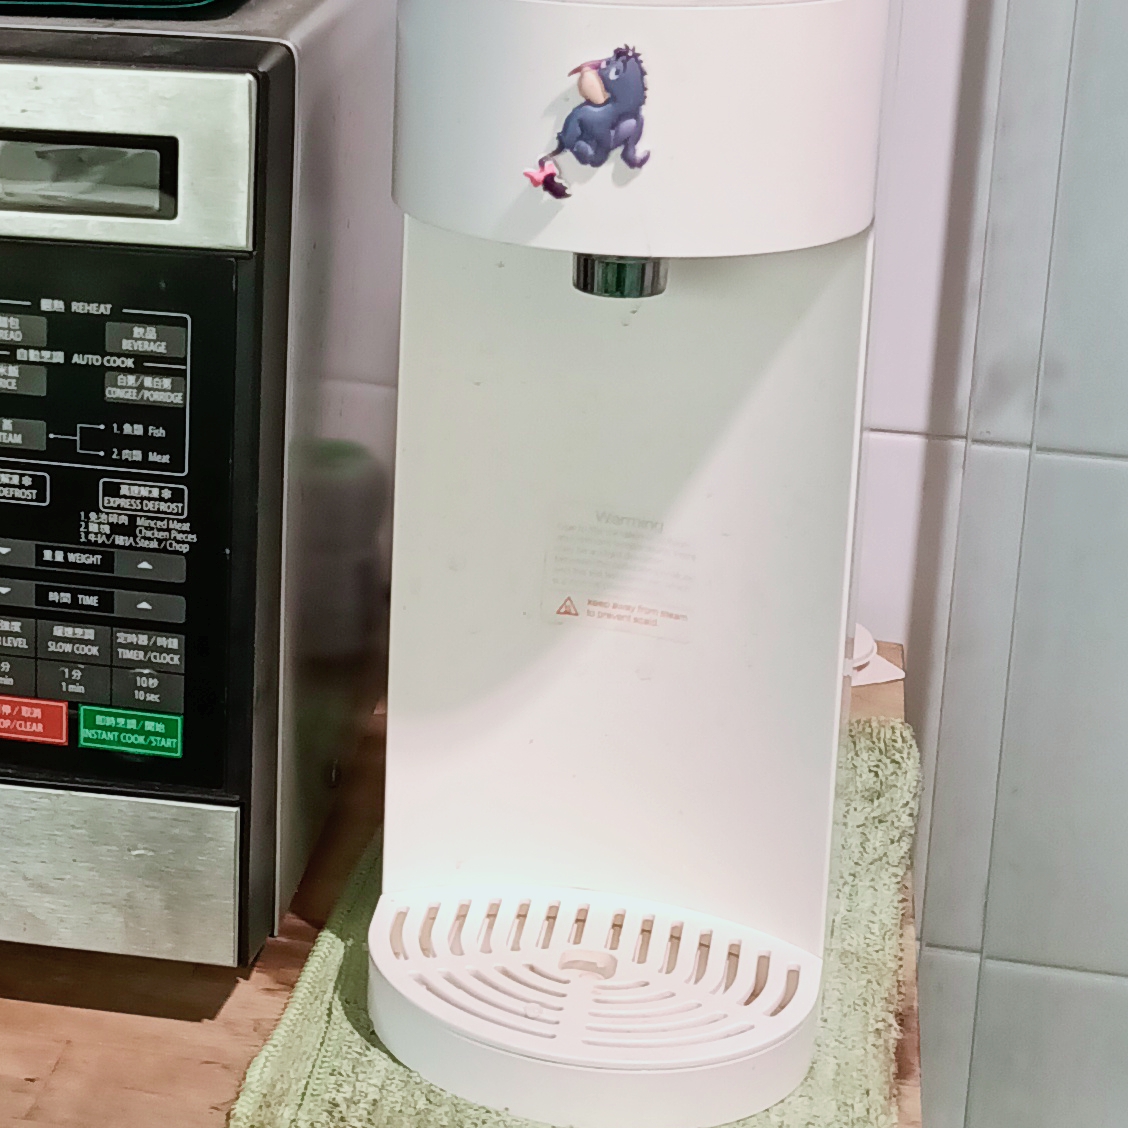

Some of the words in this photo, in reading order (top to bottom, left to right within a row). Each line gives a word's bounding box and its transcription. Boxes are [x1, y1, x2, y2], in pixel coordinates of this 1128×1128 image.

[71, 301, 112, 315] REHEAT
[122, 338, 167, 353] BEVERAGE
[72, 353, 102, 366] AUTO
[103, 356, 135, 368] COOK
[148, 426, 166, 438] Fish
[148, 451, 171, 464] Meat
[103, 496, 141, 510] EXPRESS
[143, 500, 183, 514] DEFROST
[136, 517, 167, 529] Minced
[169, 520, 191, 531] Meat
[136, 527, 170, 539] Chicken
[170, 530, 198, 543] Pieces
[136, 537, 159, 549] Steak
[166, 541, 190, 553] Chop
[67, 552, 103, 566] WEIGHT
[77, 594, 99, 607] TIME
[2, 635, 29, 649] LEVEL
[47, 641, 73, 655] SLOW
[73, 643, 100, 657] COOK
[68, 682, 85, 694] min
[134, 690, 145, 701] 10
[145, 692, 161, 703] sec
[82, 729, 118, 743] INSTANT
